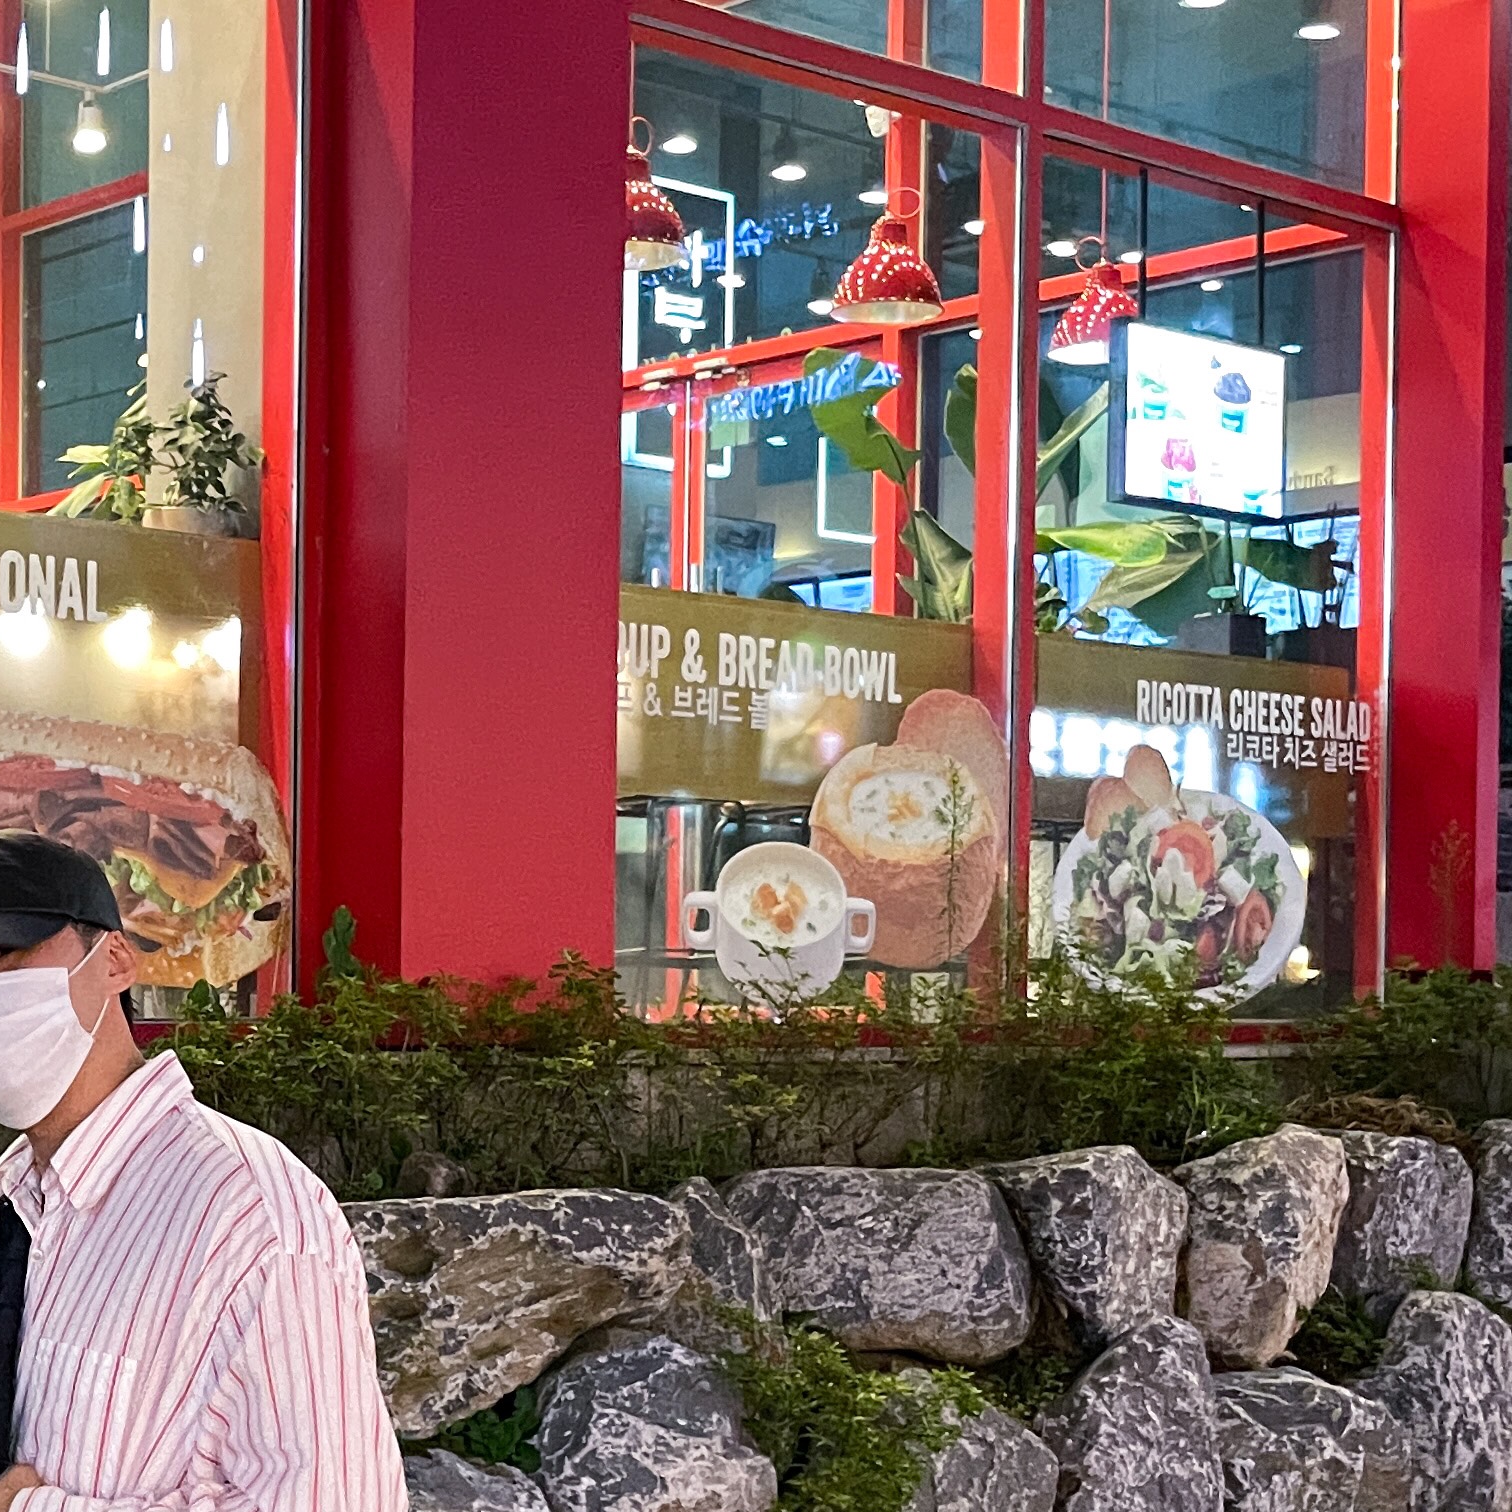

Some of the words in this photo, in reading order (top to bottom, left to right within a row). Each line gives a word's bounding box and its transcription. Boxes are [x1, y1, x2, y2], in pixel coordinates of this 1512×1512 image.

[681, 628, 707, 683] &
[718, 632, 815, 692] BREAD
[824, 645, 902, 703] BOWL
[643, 682, 663, 717] &
[671, 685, 743, 726] 브레드
[1136, 679, 1224, 730] RICOTTA
[1229, 688, 1305, 737] CHEESE
[1310, 697, 1371, 743] SALAD
[1226, 732, 1280, 769] 리코타
[1283, 737, 1318, 770] 치즈
